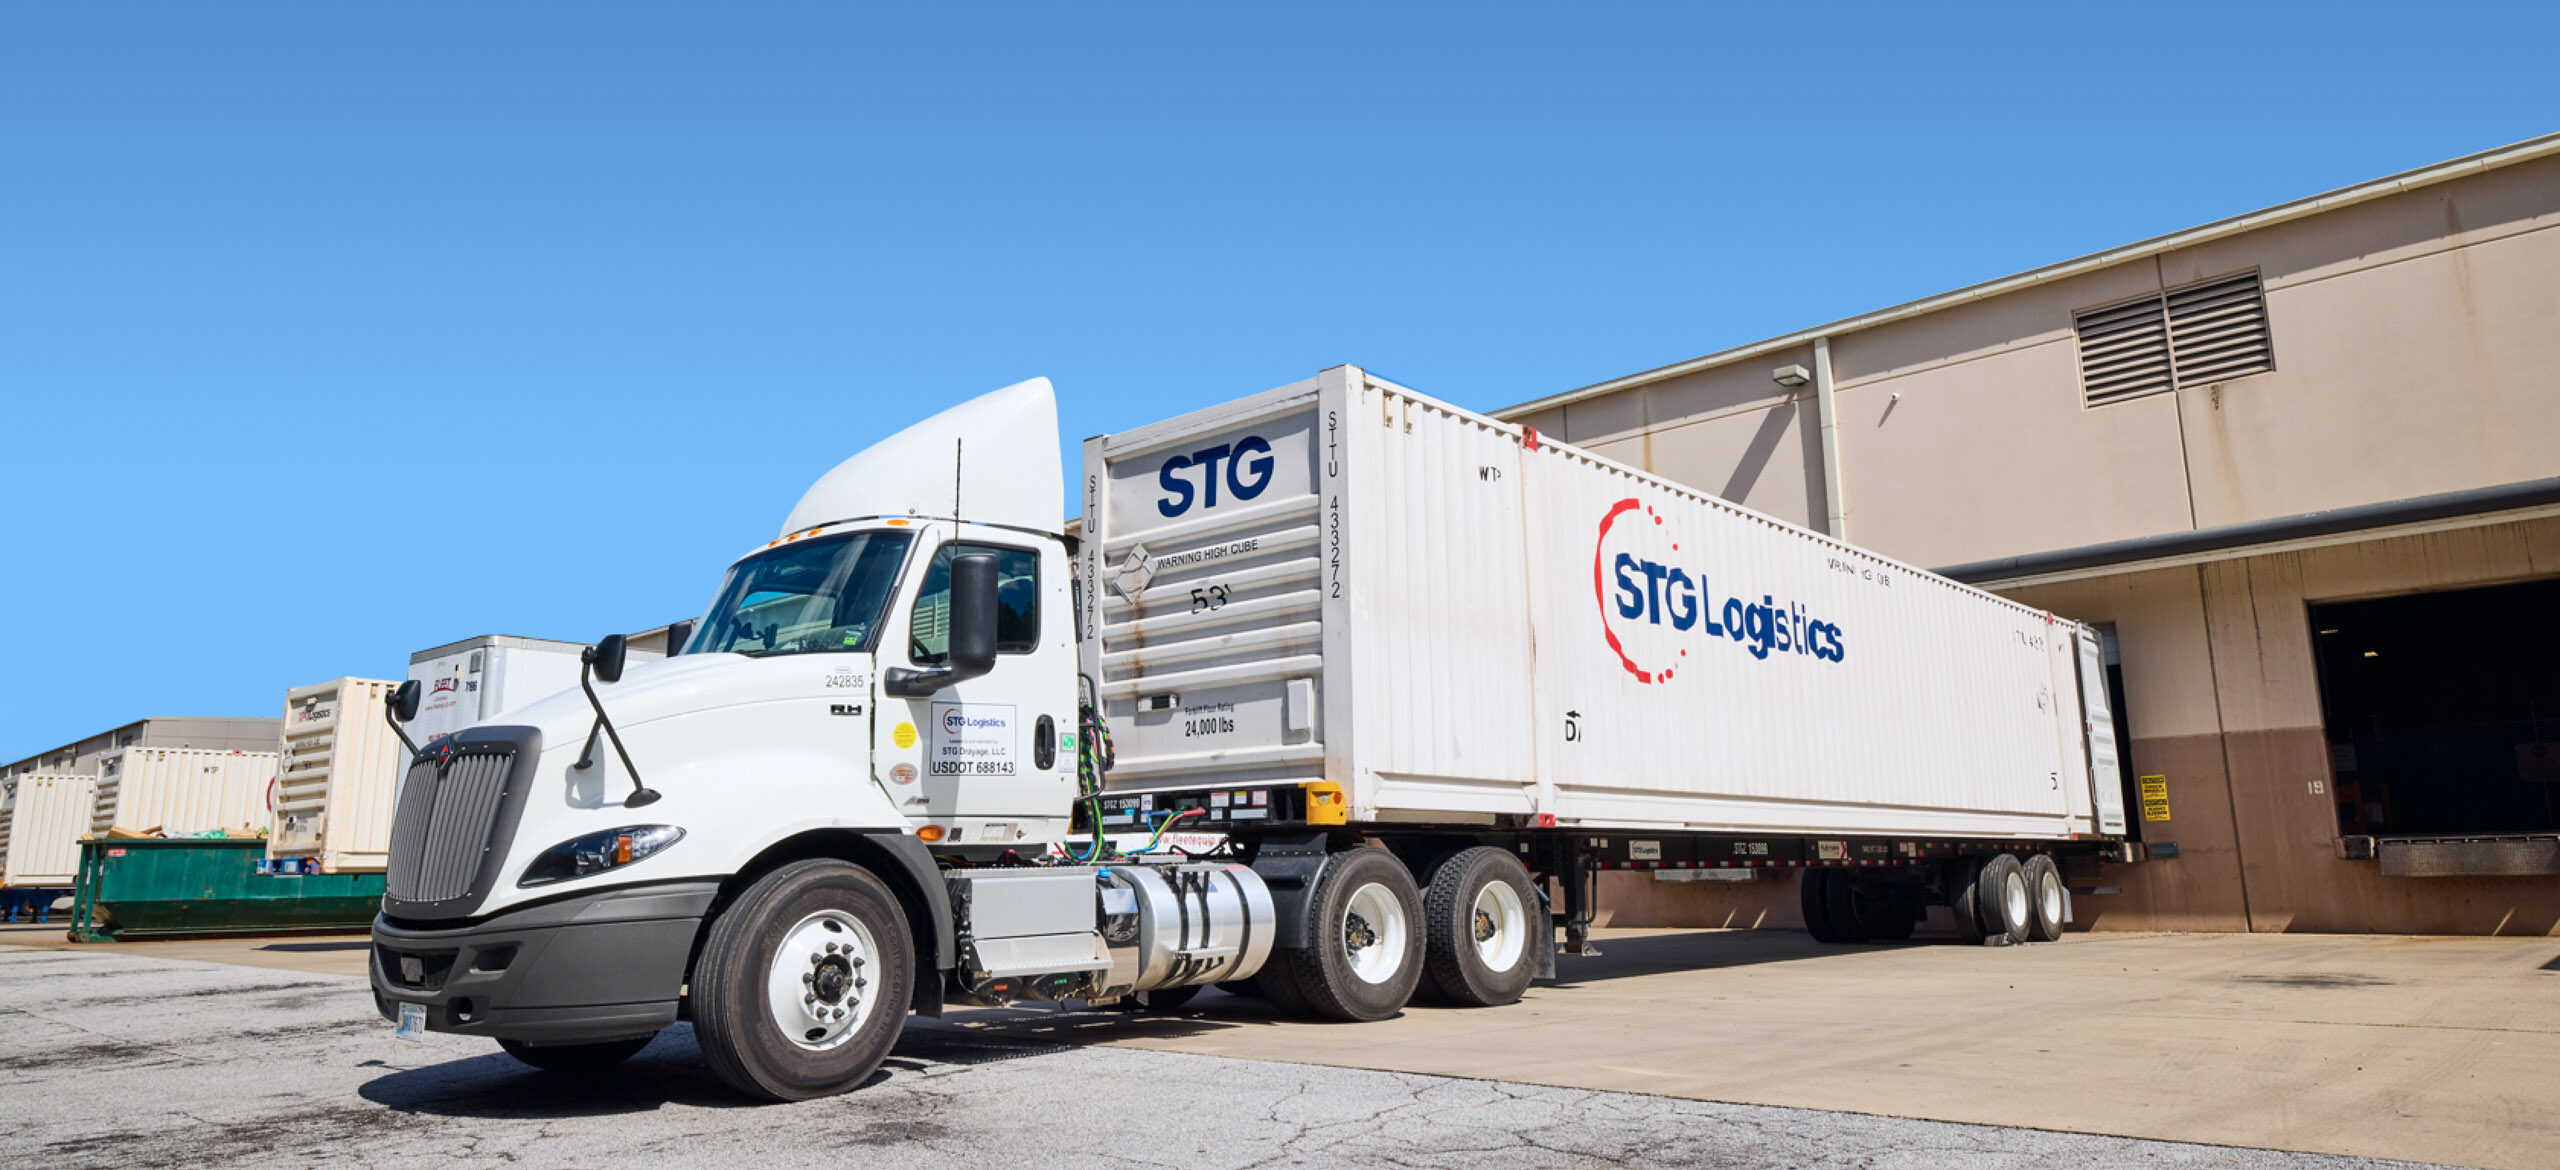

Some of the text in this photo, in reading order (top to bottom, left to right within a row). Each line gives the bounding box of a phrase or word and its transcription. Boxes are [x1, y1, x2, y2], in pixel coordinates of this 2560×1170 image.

[1158, 436, 1274, 517] STG
[1327, 410, 1340, 598] STTU 433272
[1087, 475, 1097, 640] STTU 433272
[1157, 539, 1258, 569] WARNING HIGH CUBE
[1615, 553, 1844, 663] STG Logistics
[826, 674, 864, 689] 242835
[946, 716, 1006, 729] STG Logistics
[1185, 716, 1235, 739] 24,000 lbs
[942, 746, 958, 756] STG
[991, 747, 1006, 756] LLC
[932, 761, 1014, 774] USDOT 688143
